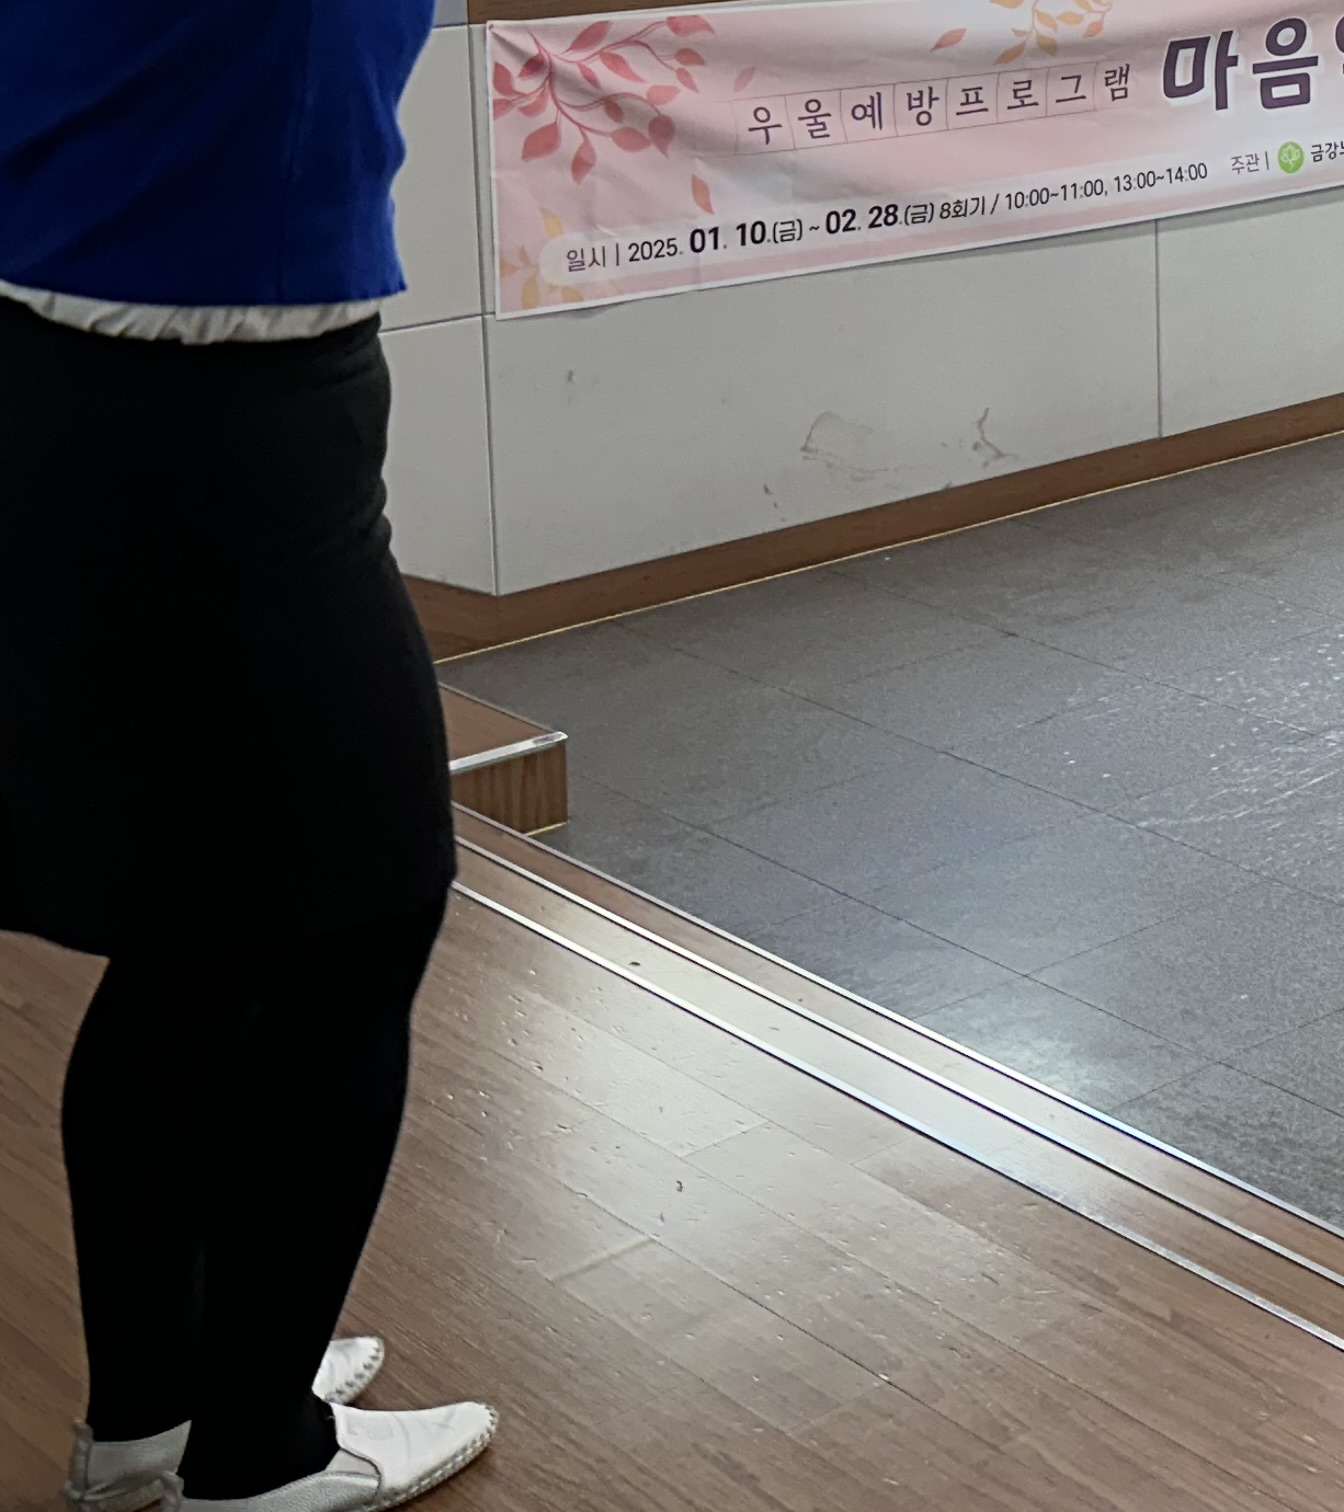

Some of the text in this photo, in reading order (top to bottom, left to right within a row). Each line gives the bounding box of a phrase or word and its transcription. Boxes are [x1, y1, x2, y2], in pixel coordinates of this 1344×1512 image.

[747, 62, 1132, 146] 우울예방프로그램
[1231, 153, 1260, 175] 주관
[566, 246, 606, 272] 일시
[628, 238, 684, 262] 2025.
[689, 226, 727, 254] 01.
[825, 208, 861, 234] 02.
[939, 196, 986, 220] 8회기
[1114, 162, 1208, 193] 13:00~14:00
